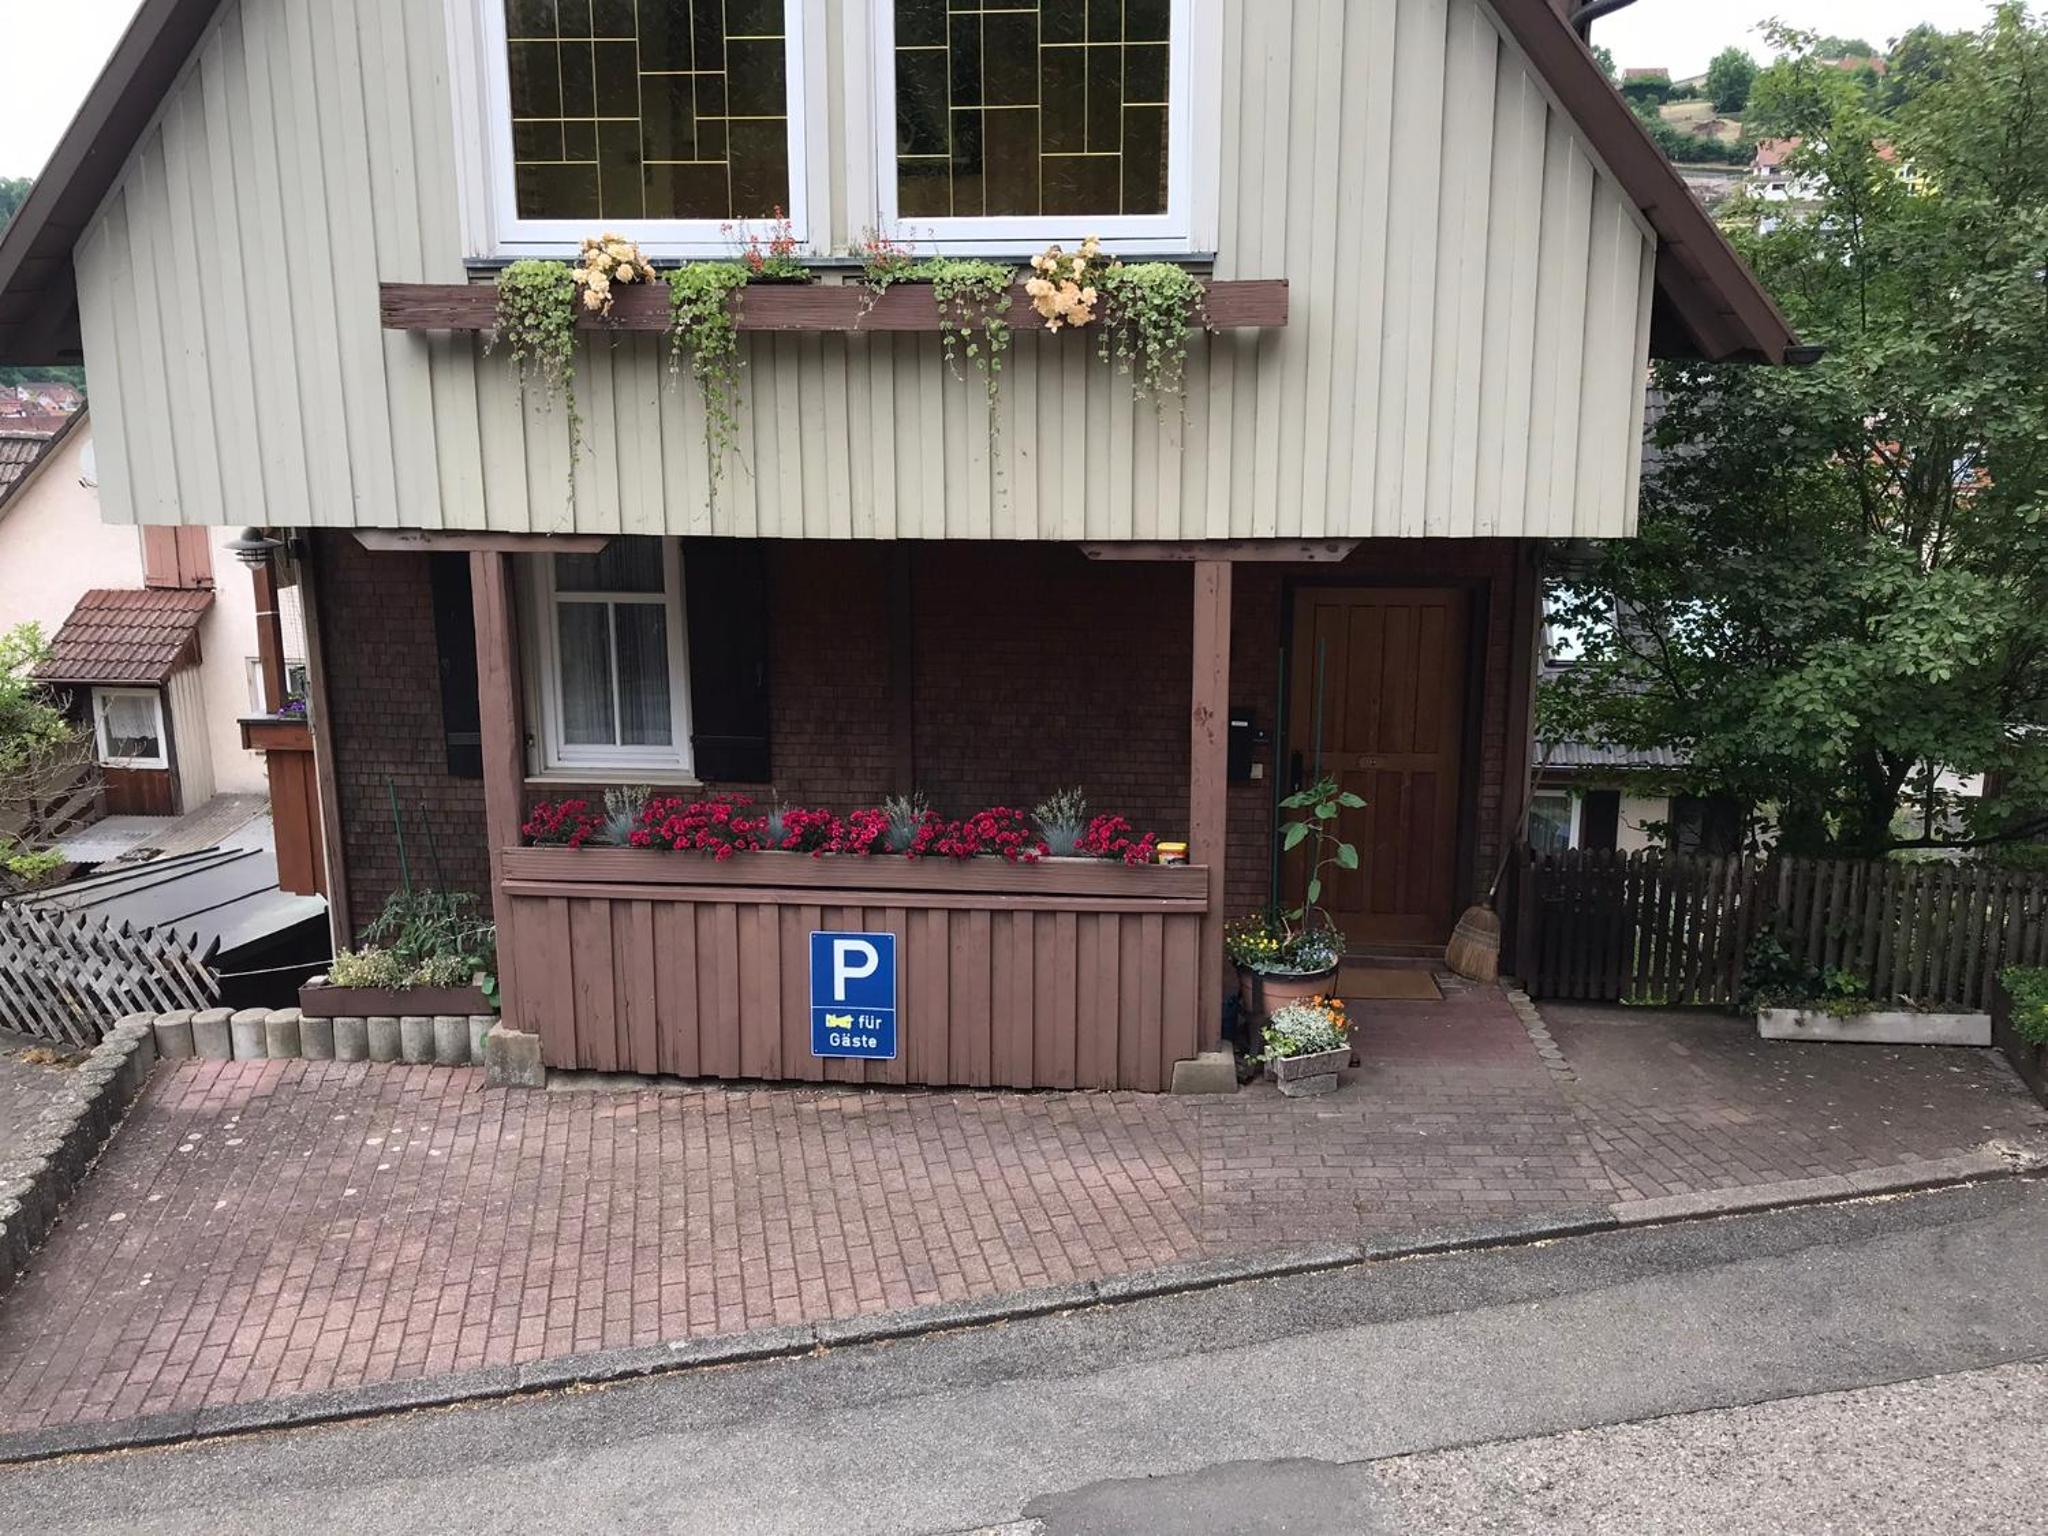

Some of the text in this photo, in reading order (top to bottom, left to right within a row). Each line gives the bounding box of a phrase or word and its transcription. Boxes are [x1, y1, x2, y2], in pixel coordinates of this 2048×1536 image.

[833, 939, 879, 1001] P
[858, 1015, 882, 1029] für
[829, 1033, 877, 1048] Gäste
